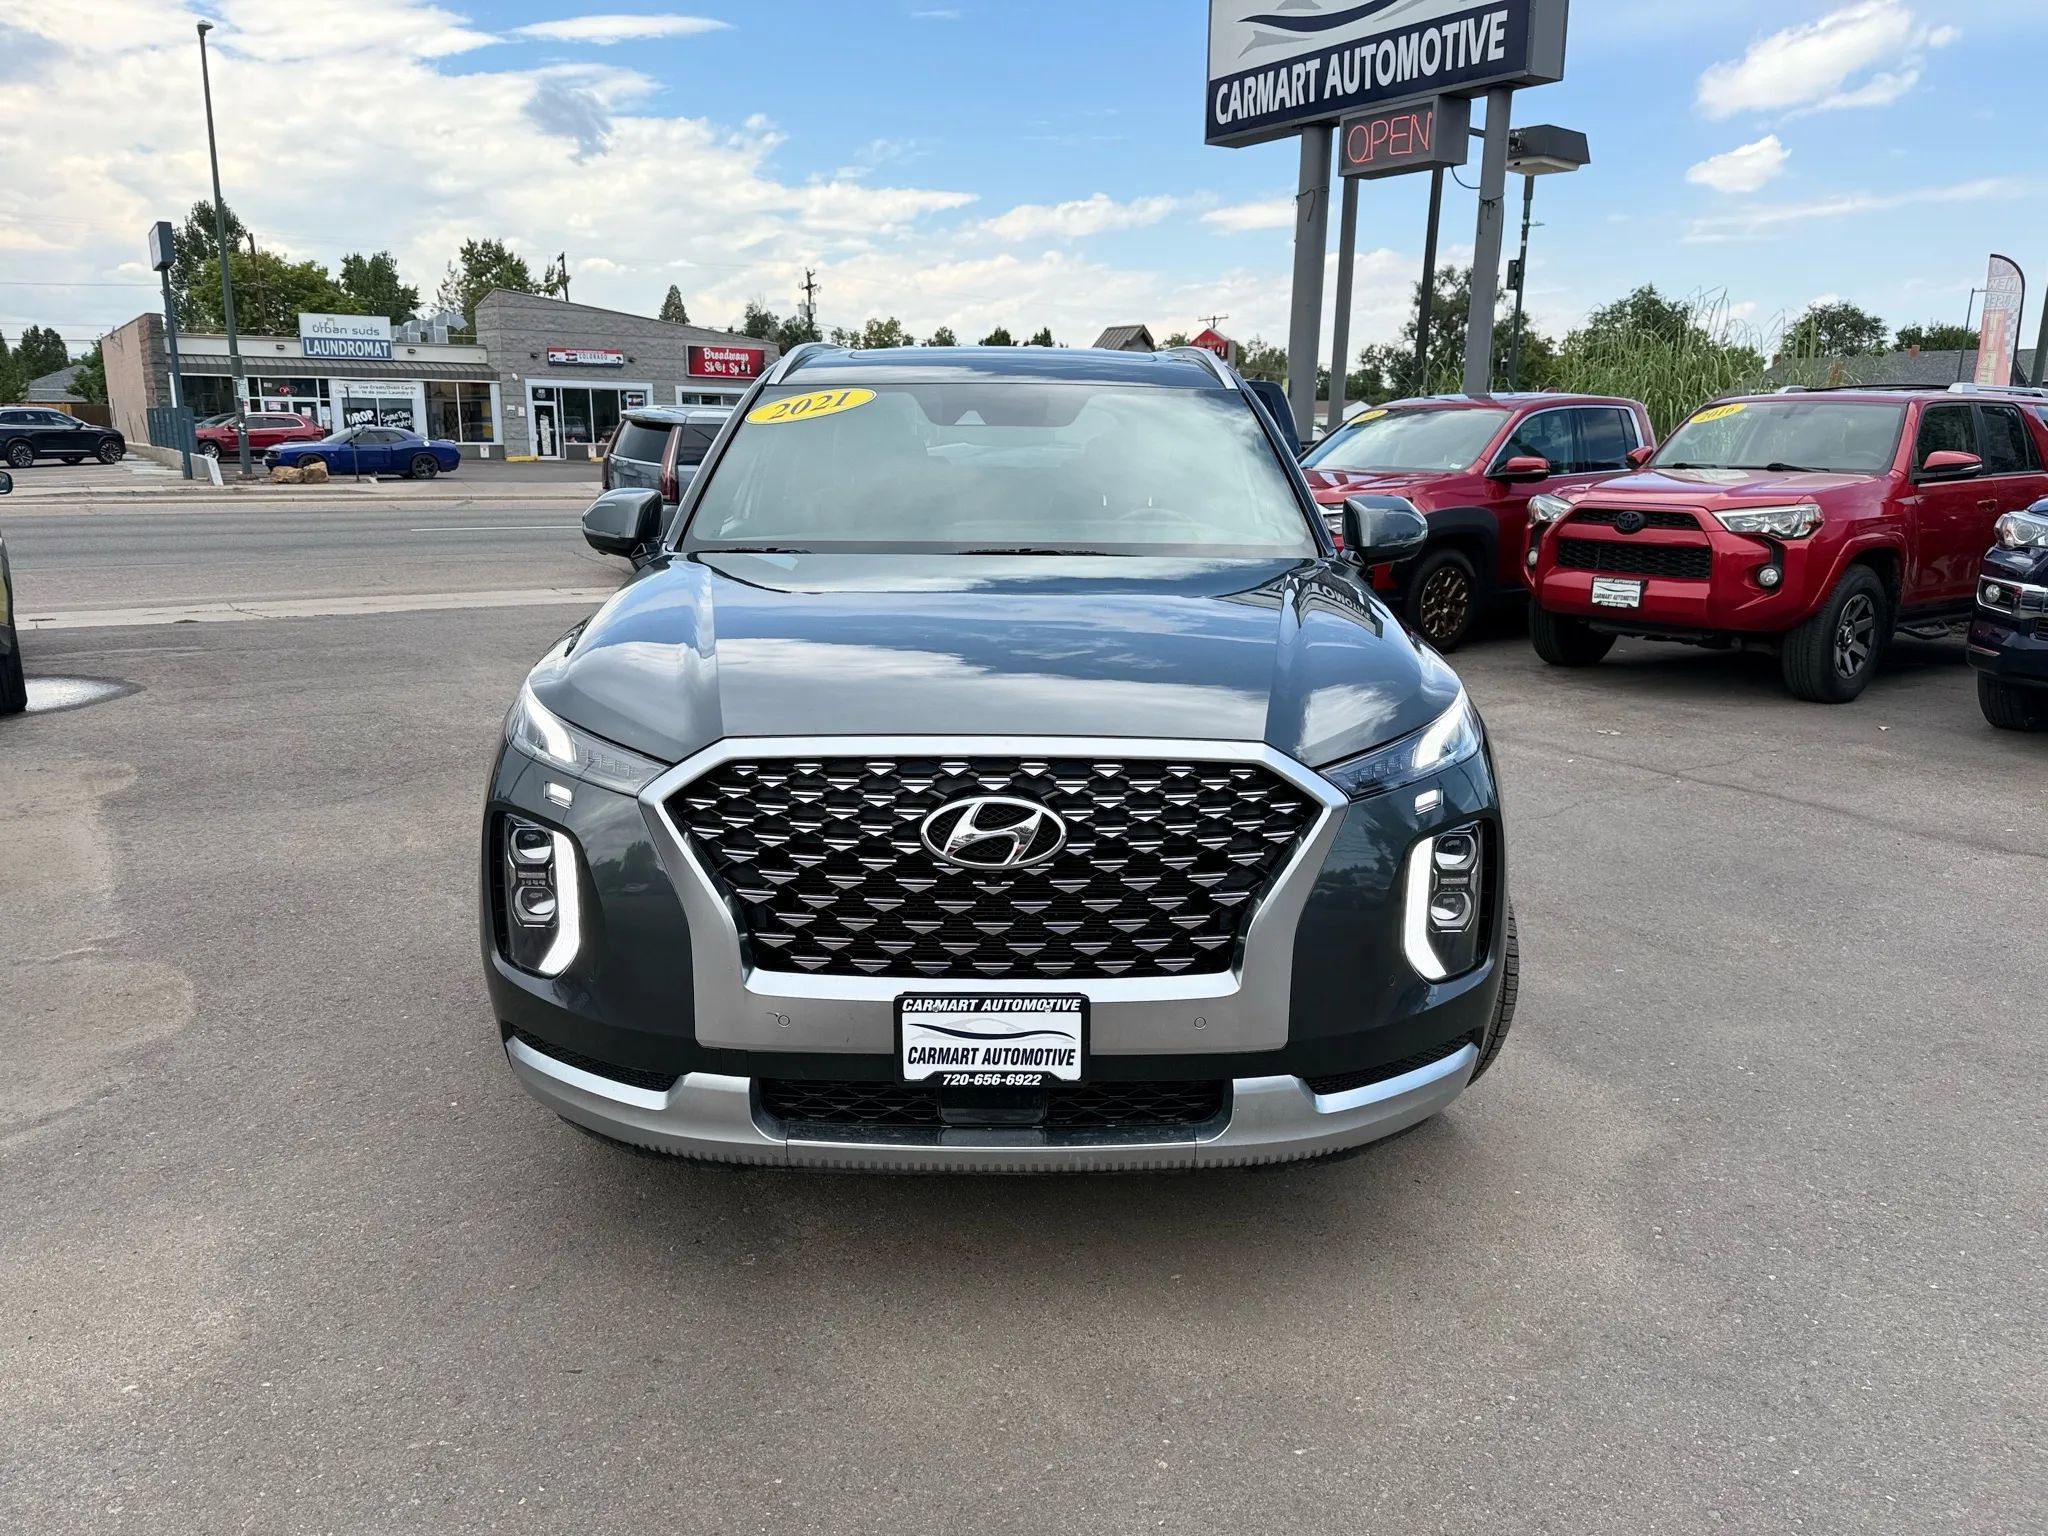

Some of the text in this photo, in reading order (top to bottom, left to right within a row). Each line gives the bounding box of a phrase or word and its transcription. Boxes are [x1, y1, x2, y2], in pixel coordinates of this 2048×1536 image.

[1215, 9, 1508, 125] CARMART AUTOMOTIVE
[1347, 112, 1432, 164] OPEN
[312, 322, 380, 336] urban suds
[305, 339, 389, 357] LAUNDROMAT
[703, 348, 749, 363] Broadways
[768, 391, 851, 420] 2021
[346, 410, 374, 425] DROP
[902, 998, 1082, 1012] CARMART AUTOMOTIVE
[908, 1047, 1076, 1066] CARMART AUTOMOTIVE
[942, 1074, 1042, 1086] 720-656-6922
